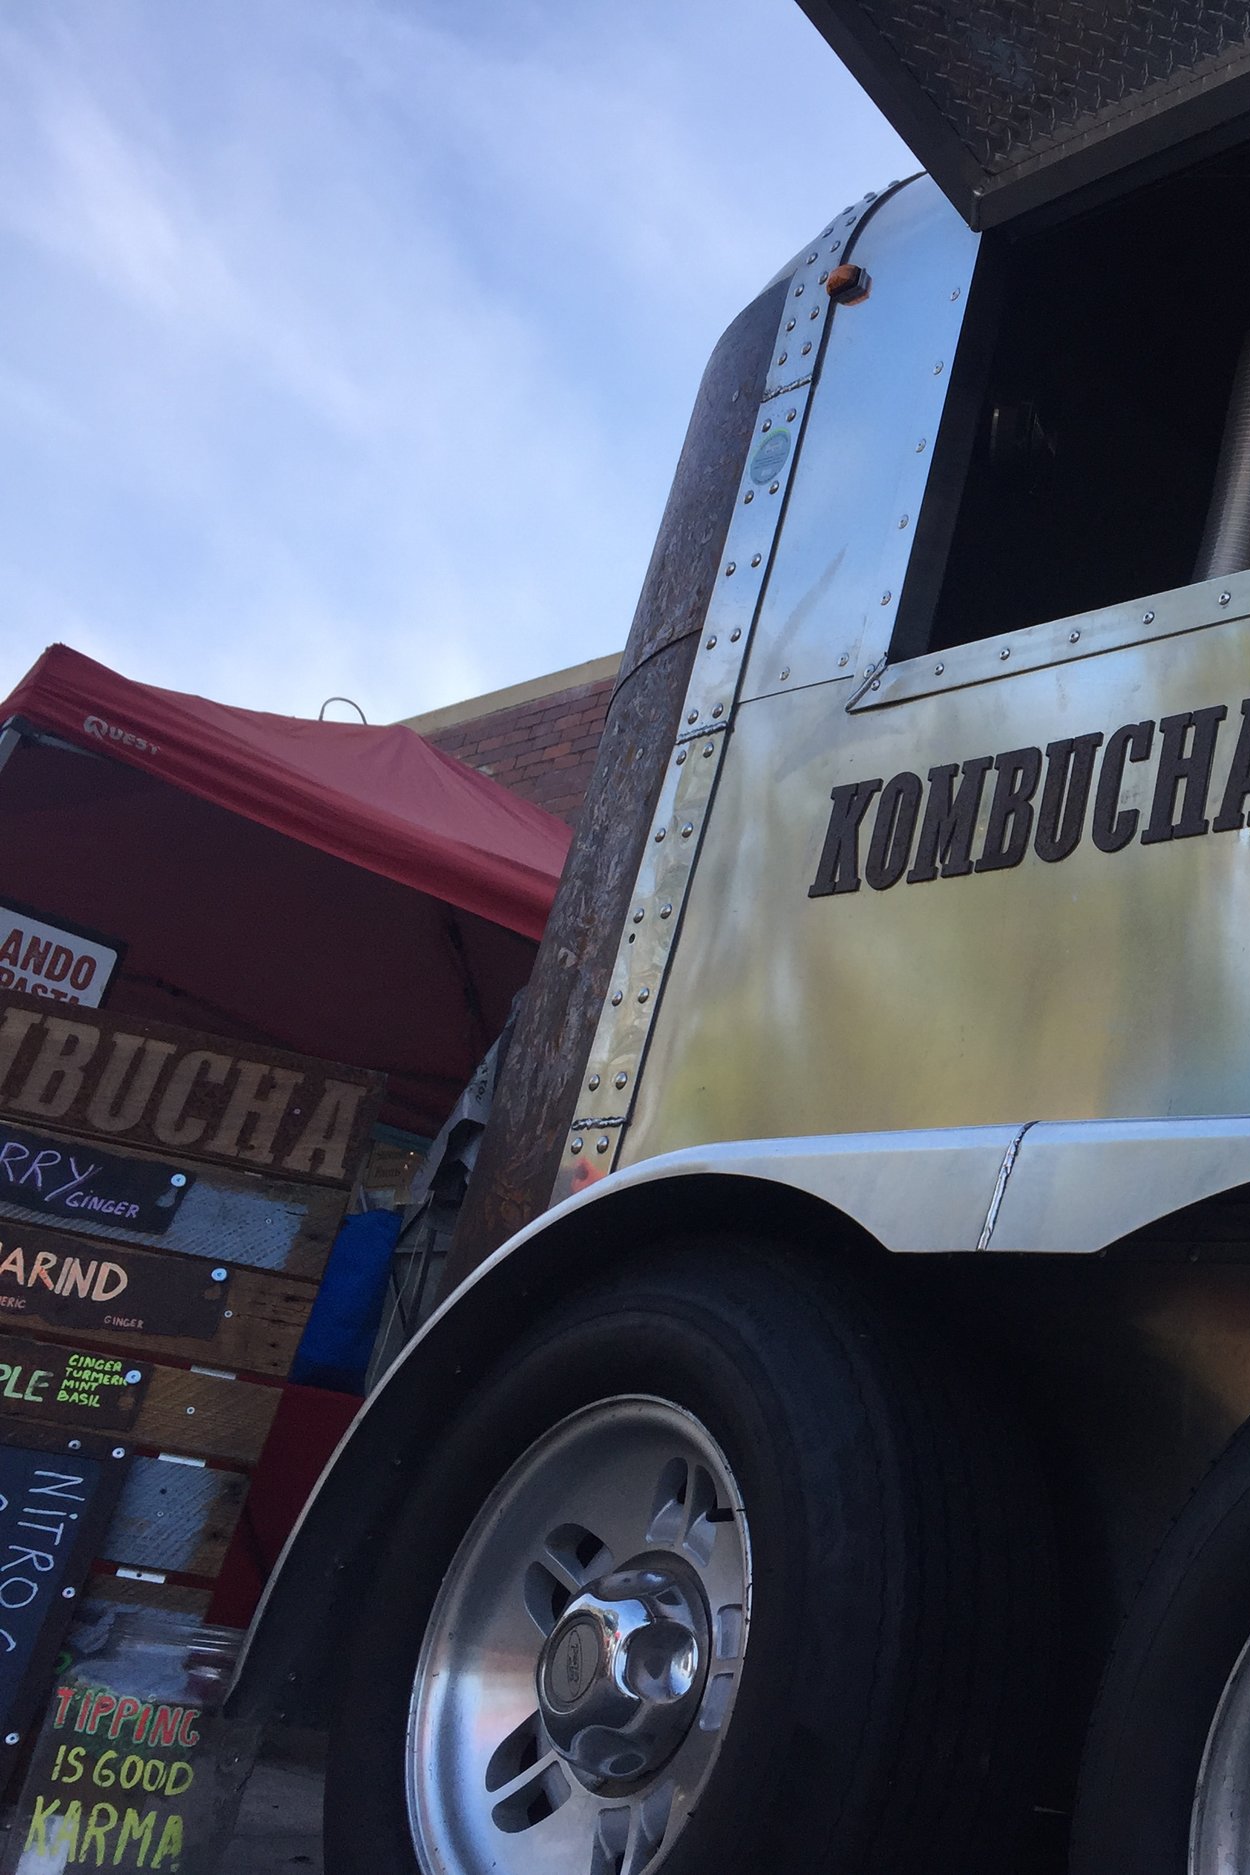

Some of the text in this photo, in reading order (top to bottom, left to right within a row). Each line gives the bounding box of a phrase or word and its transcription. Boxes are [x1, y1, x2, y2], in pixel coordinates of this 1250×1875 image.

[0, 1241, 129, 1302] ARIND
[61, 1379, 100, 1392] MINT
[68, 1354, 122, 1372] GINGER
[56, 1390, 101, 1408] BASIL
[54, 1686, 200, 1747] TIPPING
[51, 1744, 194, 1796] IS GOOD
[23, 1795, 184, 1869] KARMA
